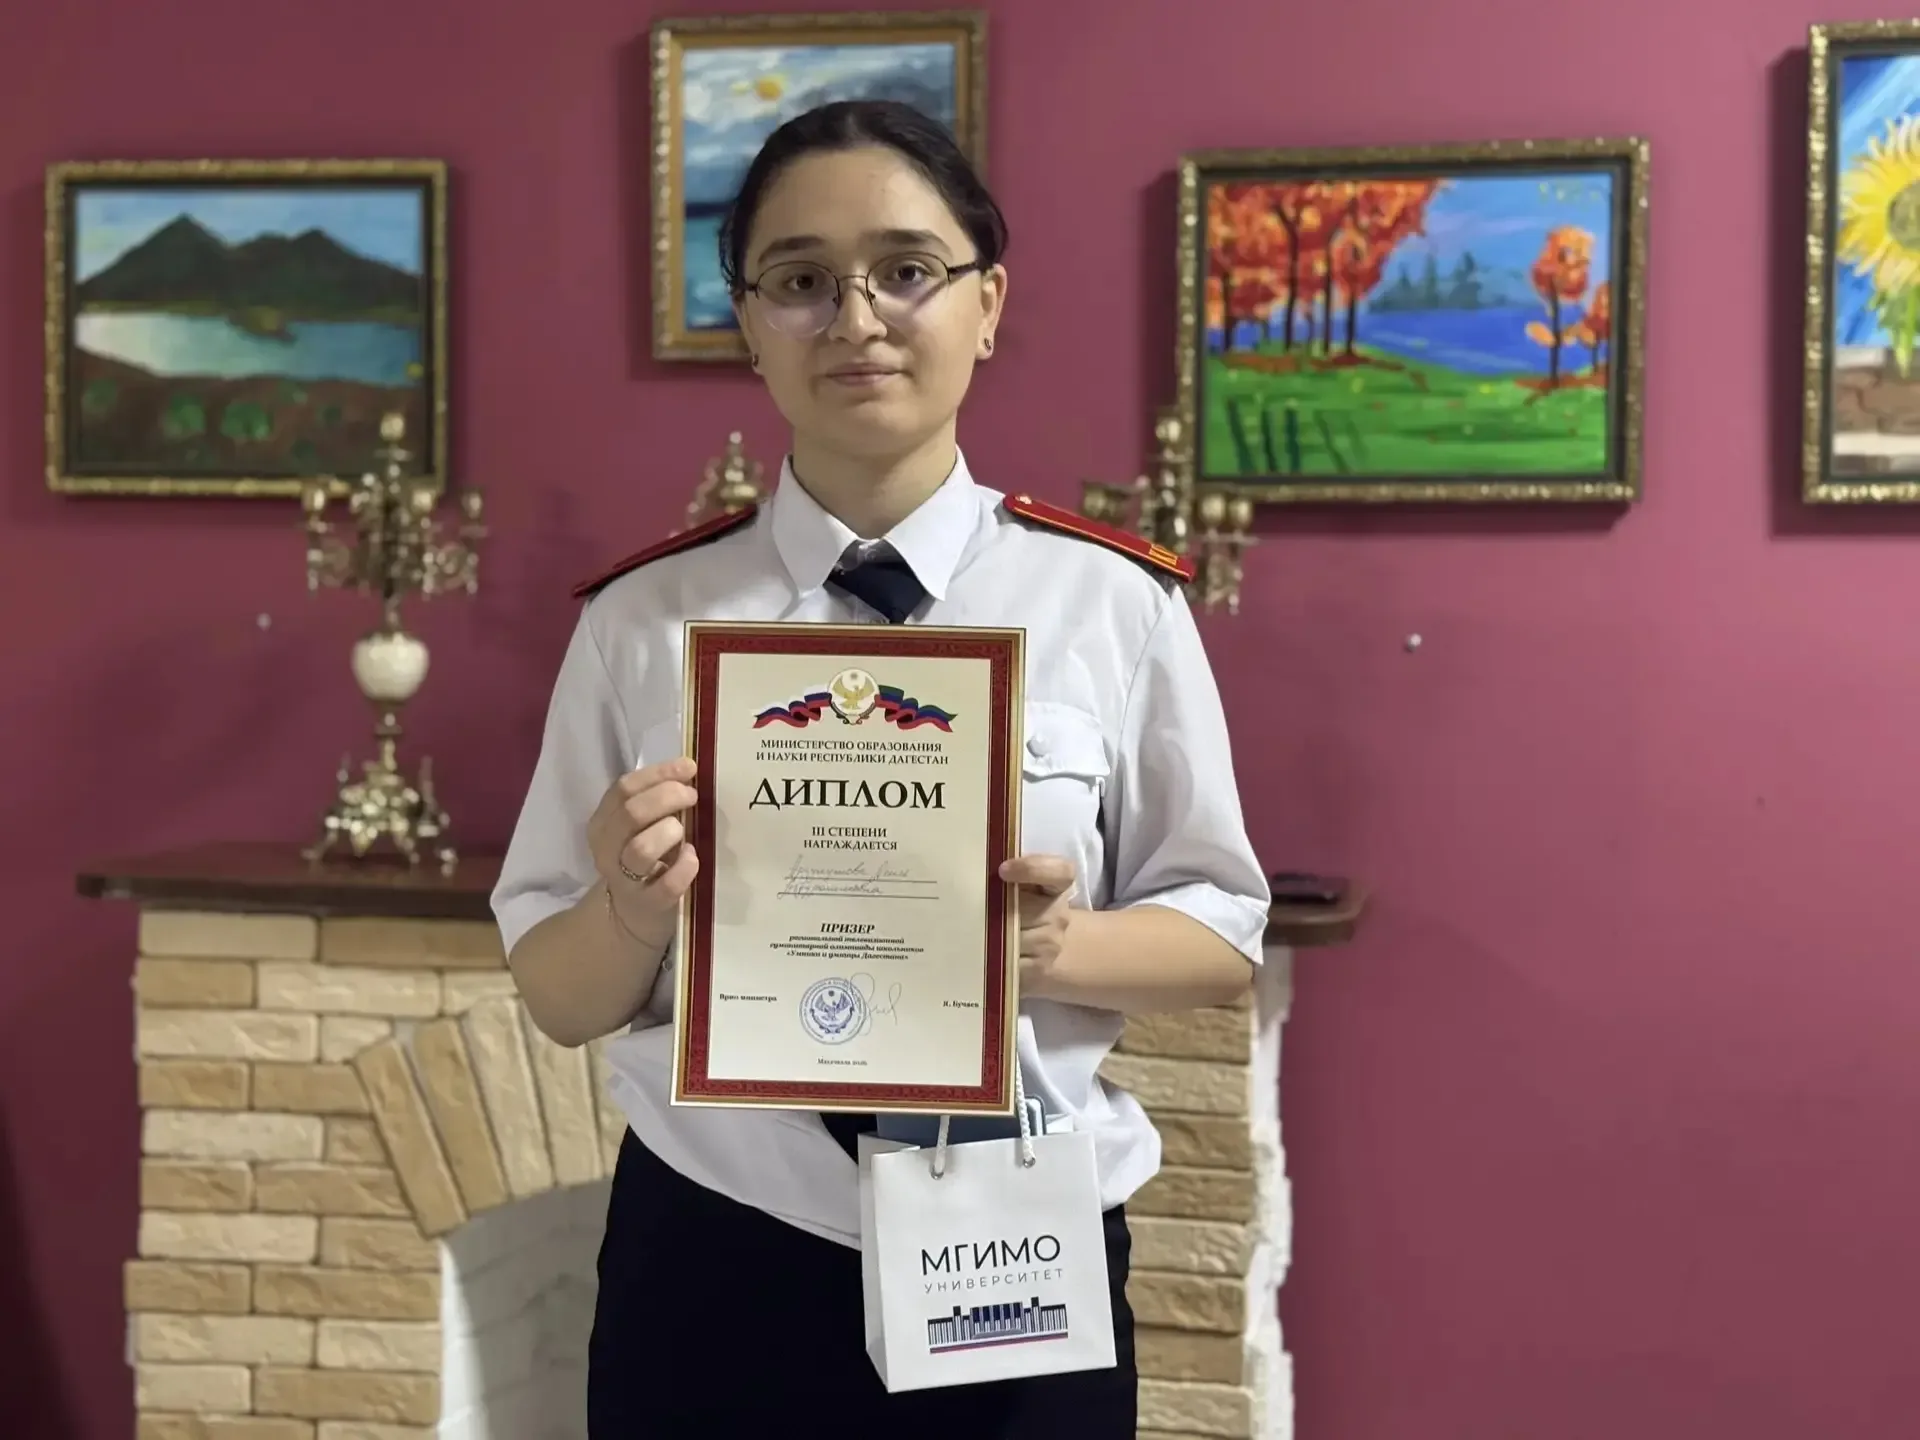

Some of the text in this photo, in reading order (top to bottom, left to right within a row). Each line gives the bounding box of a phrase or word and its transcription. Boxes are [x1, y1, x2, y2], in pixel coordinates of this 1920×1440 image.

[760, 739, 942, 752] МИНИСТЕРСТВО ОБРАЗОВАНИЯ
[756, 752, 948, 765] И НАУКИ РЕСПУБЛИКИ ДАГЕСТАН
[749, 778, 946, 811] ДИПЛОМ
[812, 826, 887, 838] III СТЕПЕНИ
[803, 839, 898, 851] НАГРАЖДАЕТСЯ
[820, 922, 875, 934] ПРИЗЕР
[921, 1235, 1061, 1276] МГИМО
[924, 1268, 1063, 1294] УНИВЕРСИТЕТ
